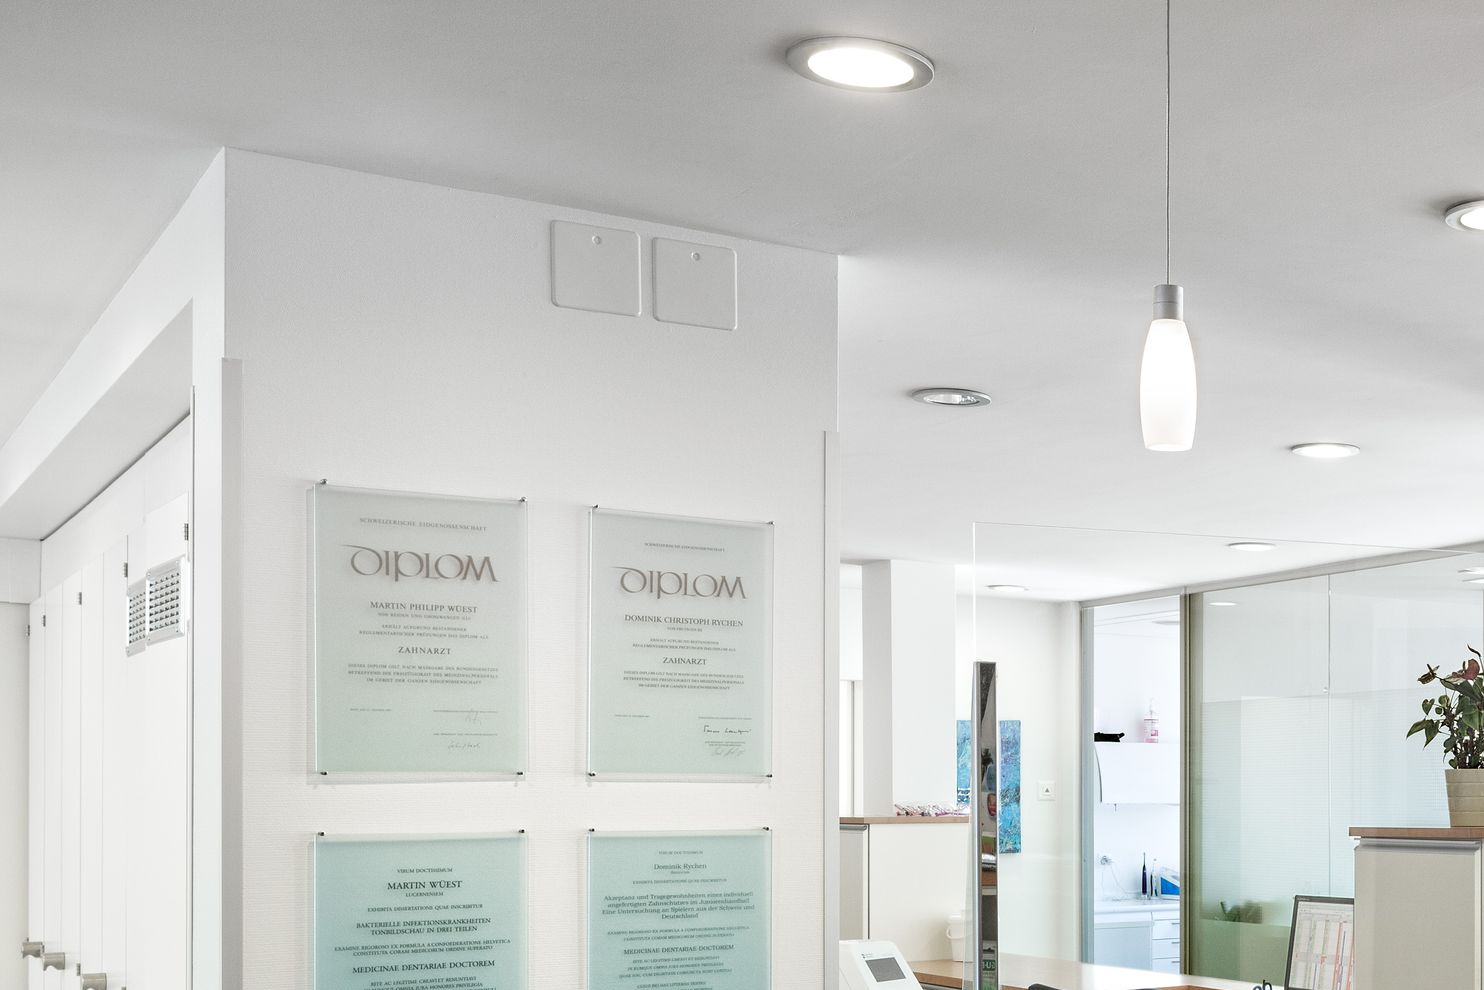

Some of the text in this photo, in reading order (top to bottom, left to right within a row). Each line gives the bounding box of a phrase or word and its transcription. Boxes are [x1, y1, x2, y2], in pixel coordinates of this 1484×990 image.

[339, 544, 500, 582] DIPLOM
[610, 566, 748, 599] DIPLOM
[370, 601, 477, 614] MARTIN PHILIPP WÜEST
[625, 614, 743, 627] DOMINIK CHRISTOPH RYCHEN
[398, 646, 451, 655] ZAHNARZT
[663, 657, 706, 665] ZAHNARZT
[388, 880, 462, 890] MARTIN WÜEST
[403, 918, 491, 927] INFEKTIONSKRANKHEITEN
[353, 960, 495, 974] MEDICINAE DENTARIAE DOCTOREM
